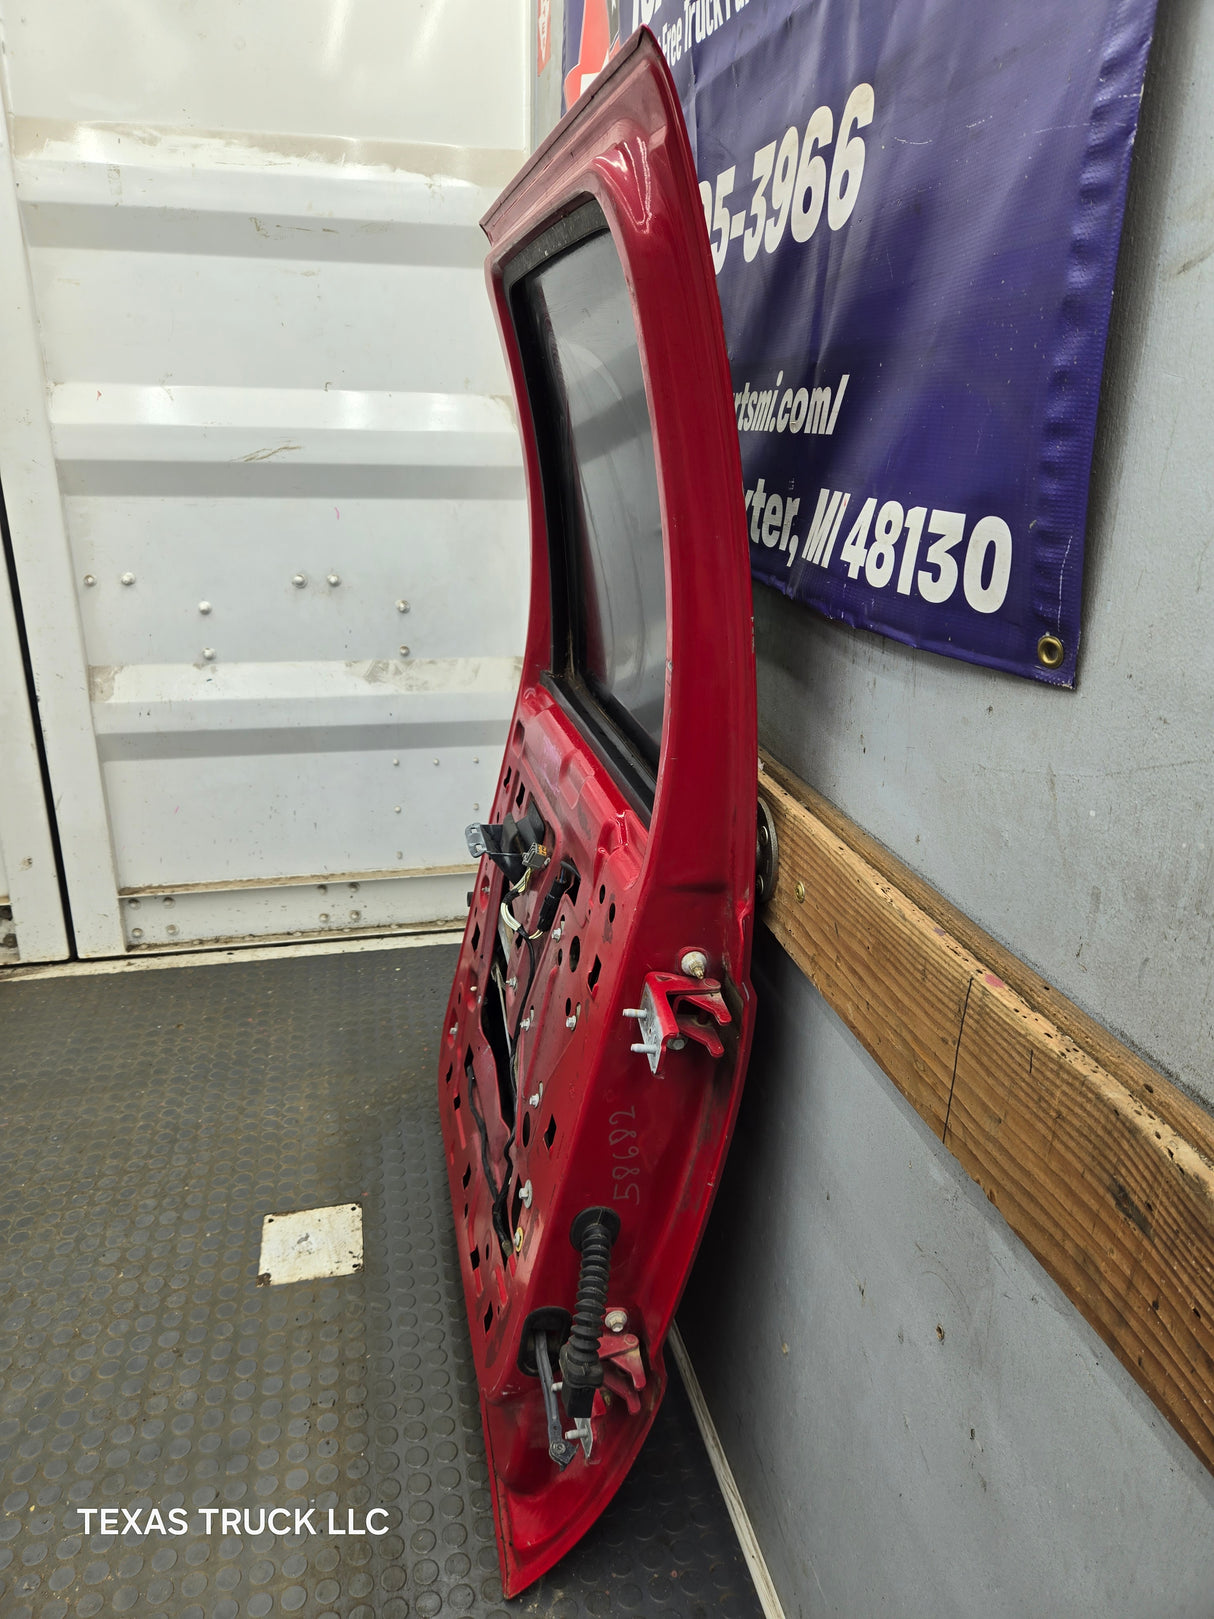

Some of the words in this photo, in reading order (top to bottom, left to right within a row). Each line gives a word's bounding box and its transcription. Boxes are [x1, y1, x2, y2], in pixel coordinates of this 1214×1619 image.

[733, 370, 850, 435] rtsmi.com/
[801, 487, 852, 569] MI
[840, 497, 1013, 614] 48130
[608, 1105, 641, 1206] 58682
